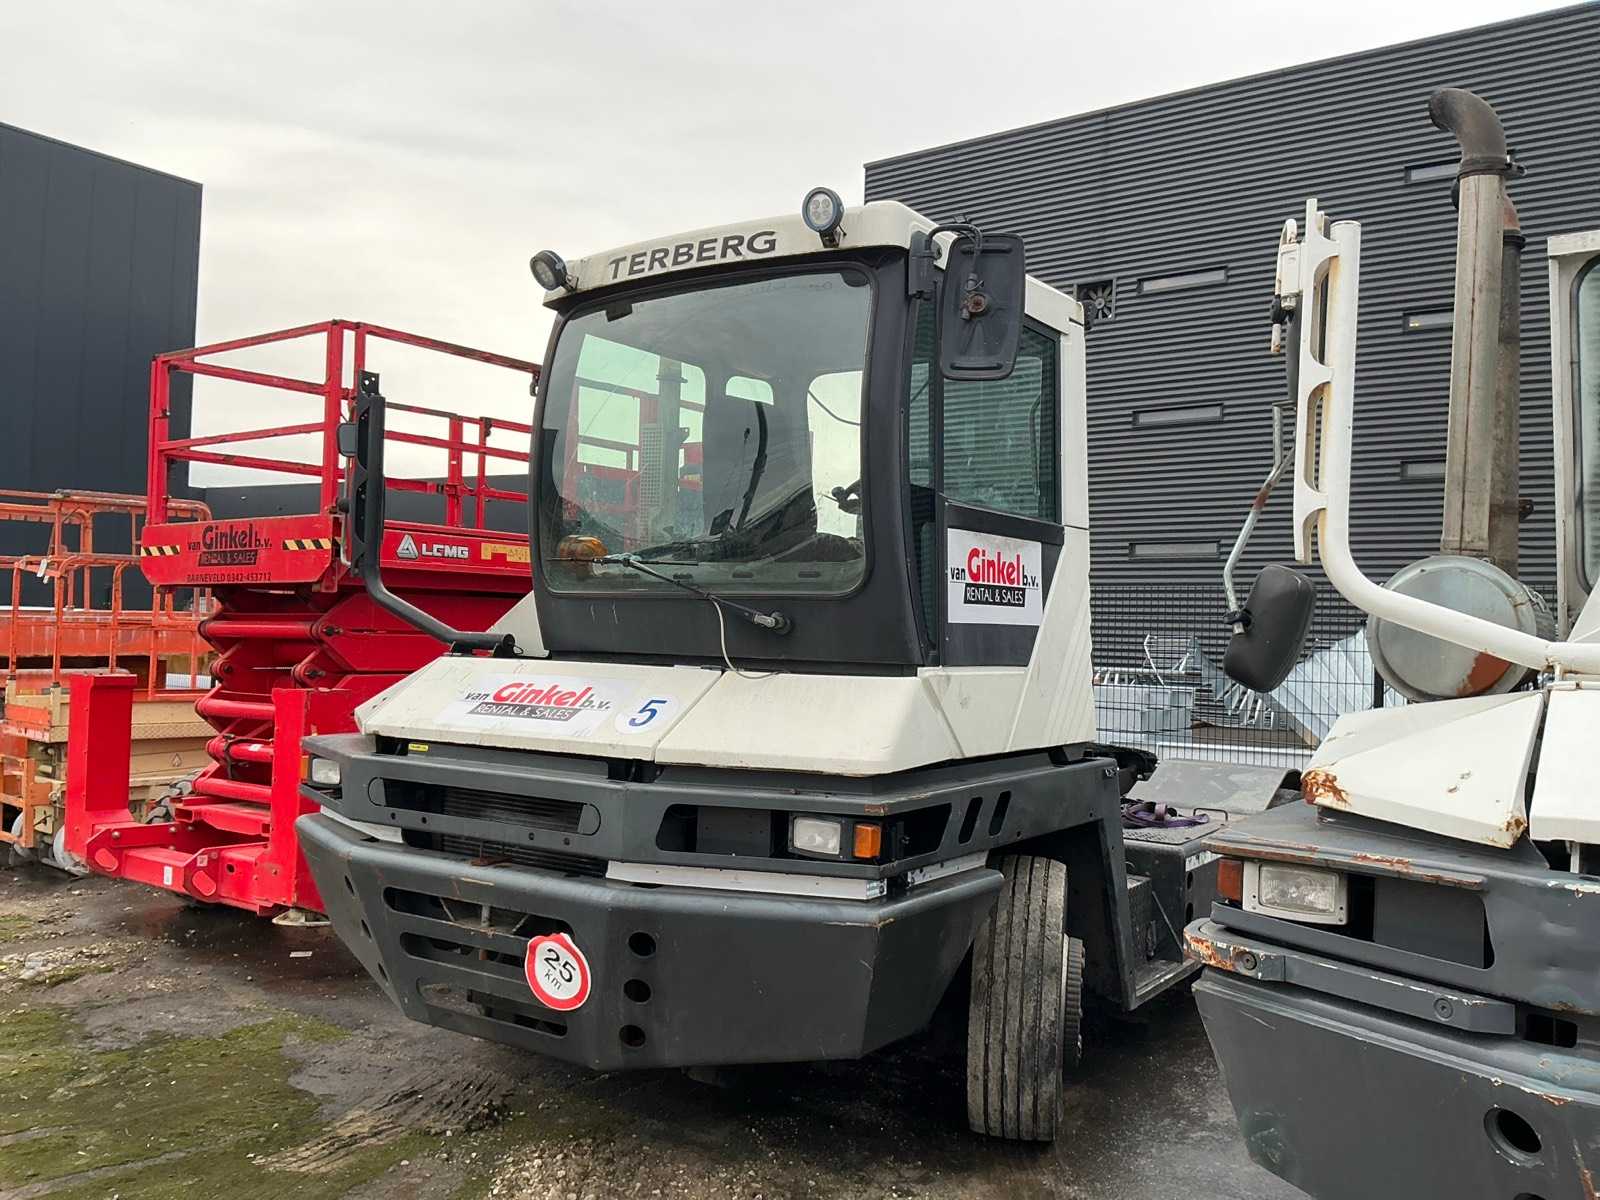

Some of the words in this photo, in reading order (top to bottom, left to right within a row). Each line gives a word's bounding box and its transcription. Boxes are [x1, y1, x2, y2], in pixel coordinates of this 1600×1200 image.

[608, 230, 777, 280] TERBERG
[188, 541, 201, 550] van
[202, 523, 253, 550] Ginkel
[255, 531, 273, 549] b.v.
[186, 573, 226, 583] BARNEVELD
[950, 566, 966, 581] van
[967, 547, 1021, 586] Ginkel
[1022, 564, 1039, 588] b.v.
[966, 587, 993, 602] RENTAL
[995, 589, 1001, 602] &
[1002, 589, 1024, 604] SALES
[464, 690, 490, 701] van
[493, 682, 593, 707] Ginkel
[580, 693, 610, 710] b.v.
[475, 702, 518, 716] RENTAL
[519, 706, 530, 717] &
[532, 707, 571, 720] SALES
[628, 699, 667, 727] 5
[543, 948, 577, 983] 25
[544, 969, 562, 990] km
